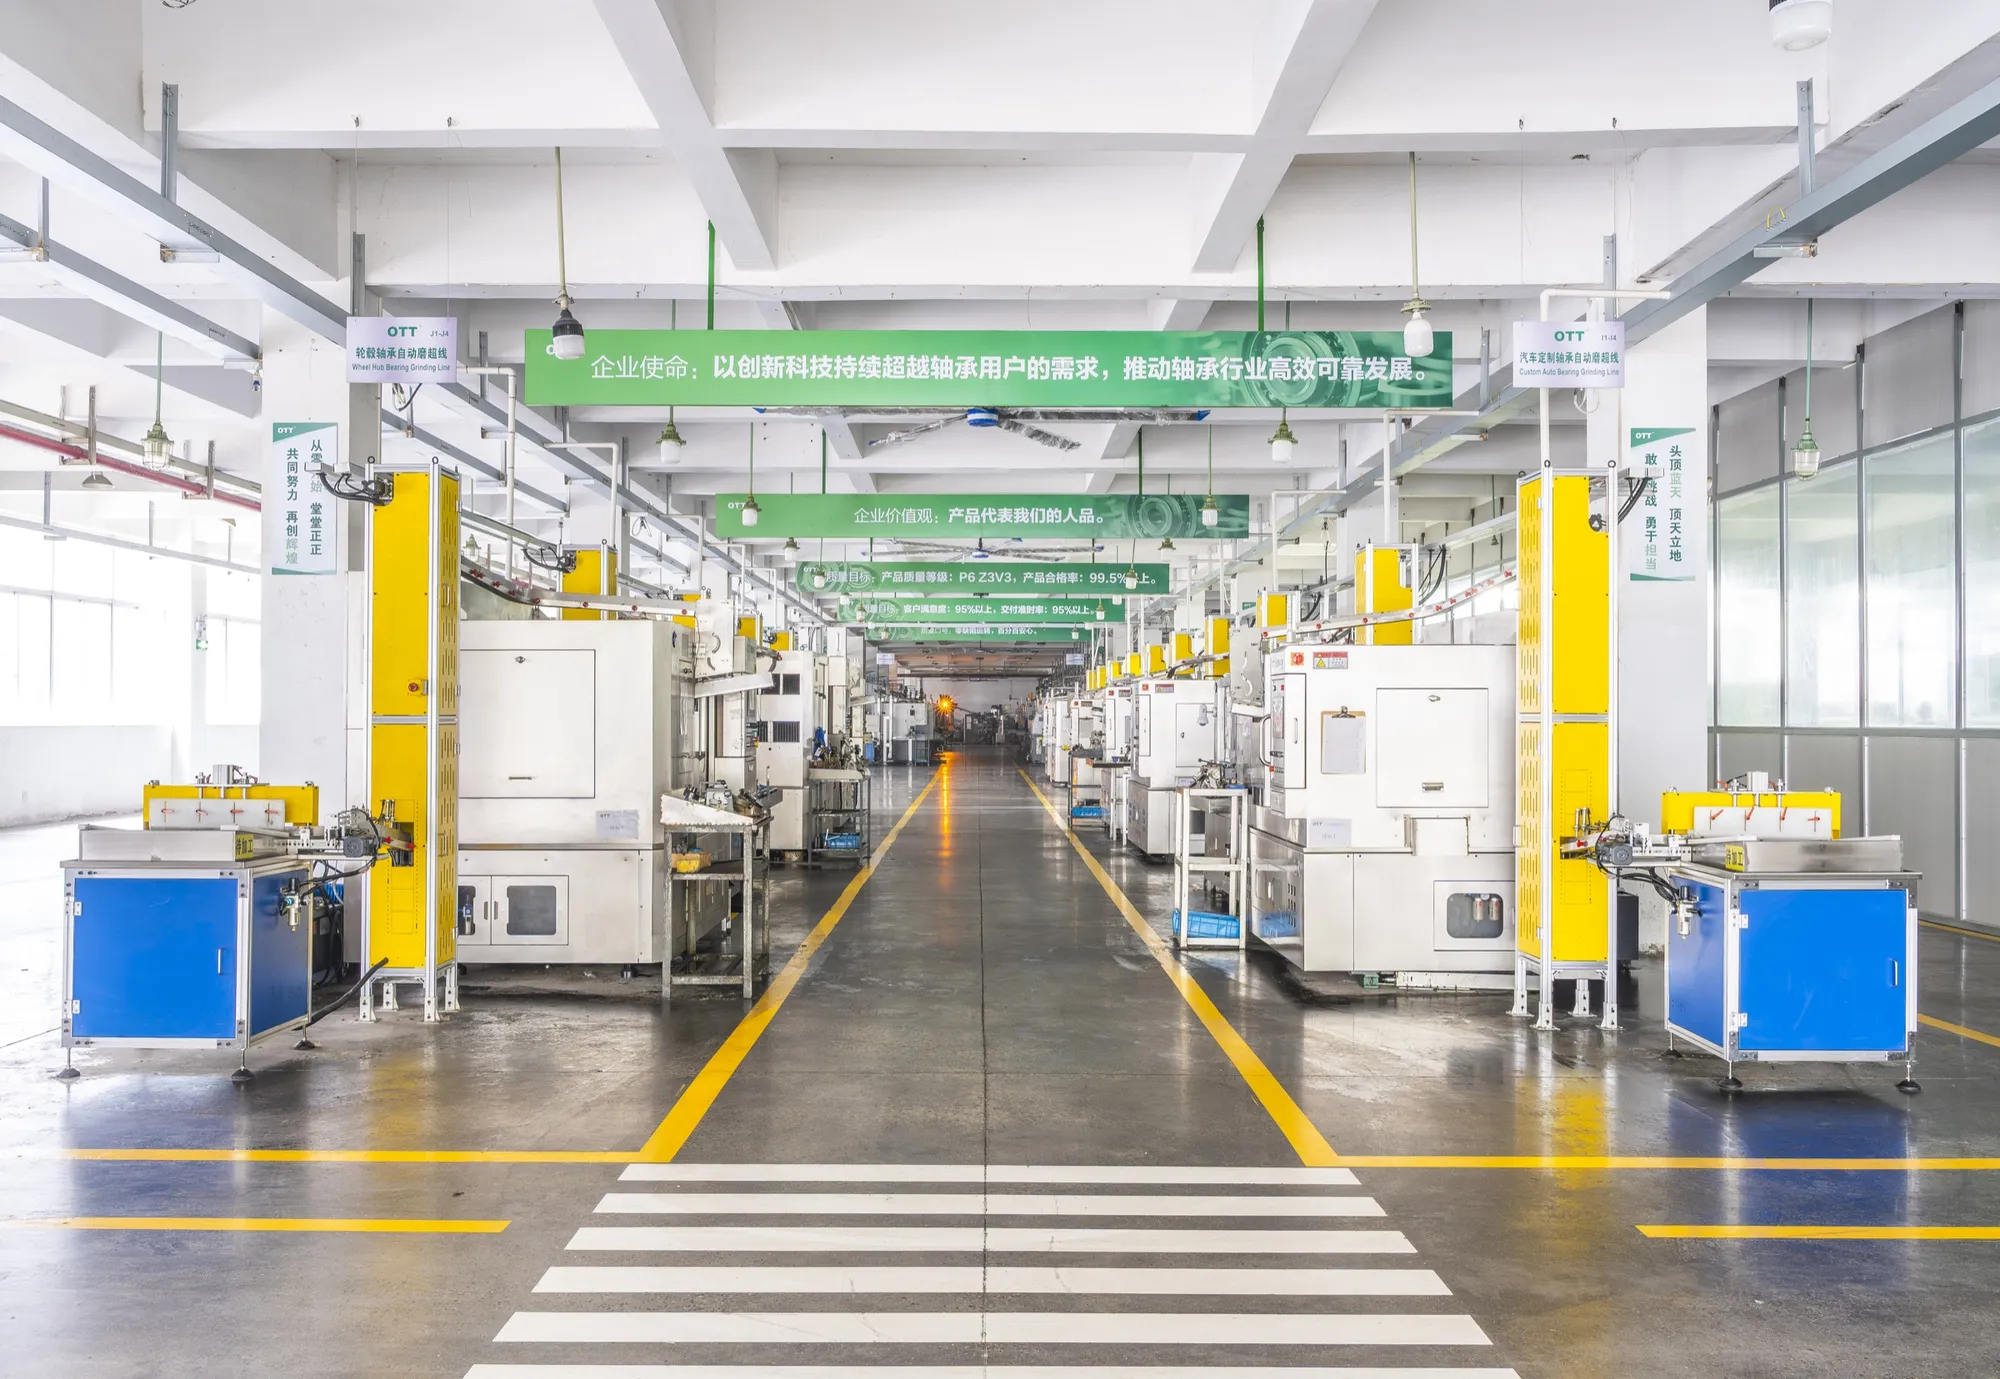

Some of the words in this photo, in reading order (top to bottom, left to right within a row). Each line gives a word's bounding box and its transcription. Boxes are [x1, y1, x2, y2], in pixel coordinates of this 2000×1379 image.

[356, 347, 448, 359] 轮毂轴承自动磨超线
[387, 326, 418, 337] OTT
[1520, 352, 1619, 364] 汽车定制轴承自动磨超线
[1554, 331, 1585, 341] OTT
[386, 364, 409, 373] Bearing
[411, 364, 436, 373] Grinding
[1557, 368, 1579, 377] Bearing
[1581, 368, 1606, 377] Grinding
[286, 447, 299, 502] 共同努力
[310, 439, 323, 493] 从零始
[1645, 453, 1657, 507] 敢挑战
[1669, 445, 1682, 499] 头顶蓝天
[286, 510, 298, 565] 再创辉煌
[310, 502, 322, 556] 堂堂正正
[1645, 516, 1657, 571] 勇于担当
[1669, 508, 1682, 562] 顶天立地
[978, 571, 1156, 584] Z3V3，产品合格率：99.5%上。
